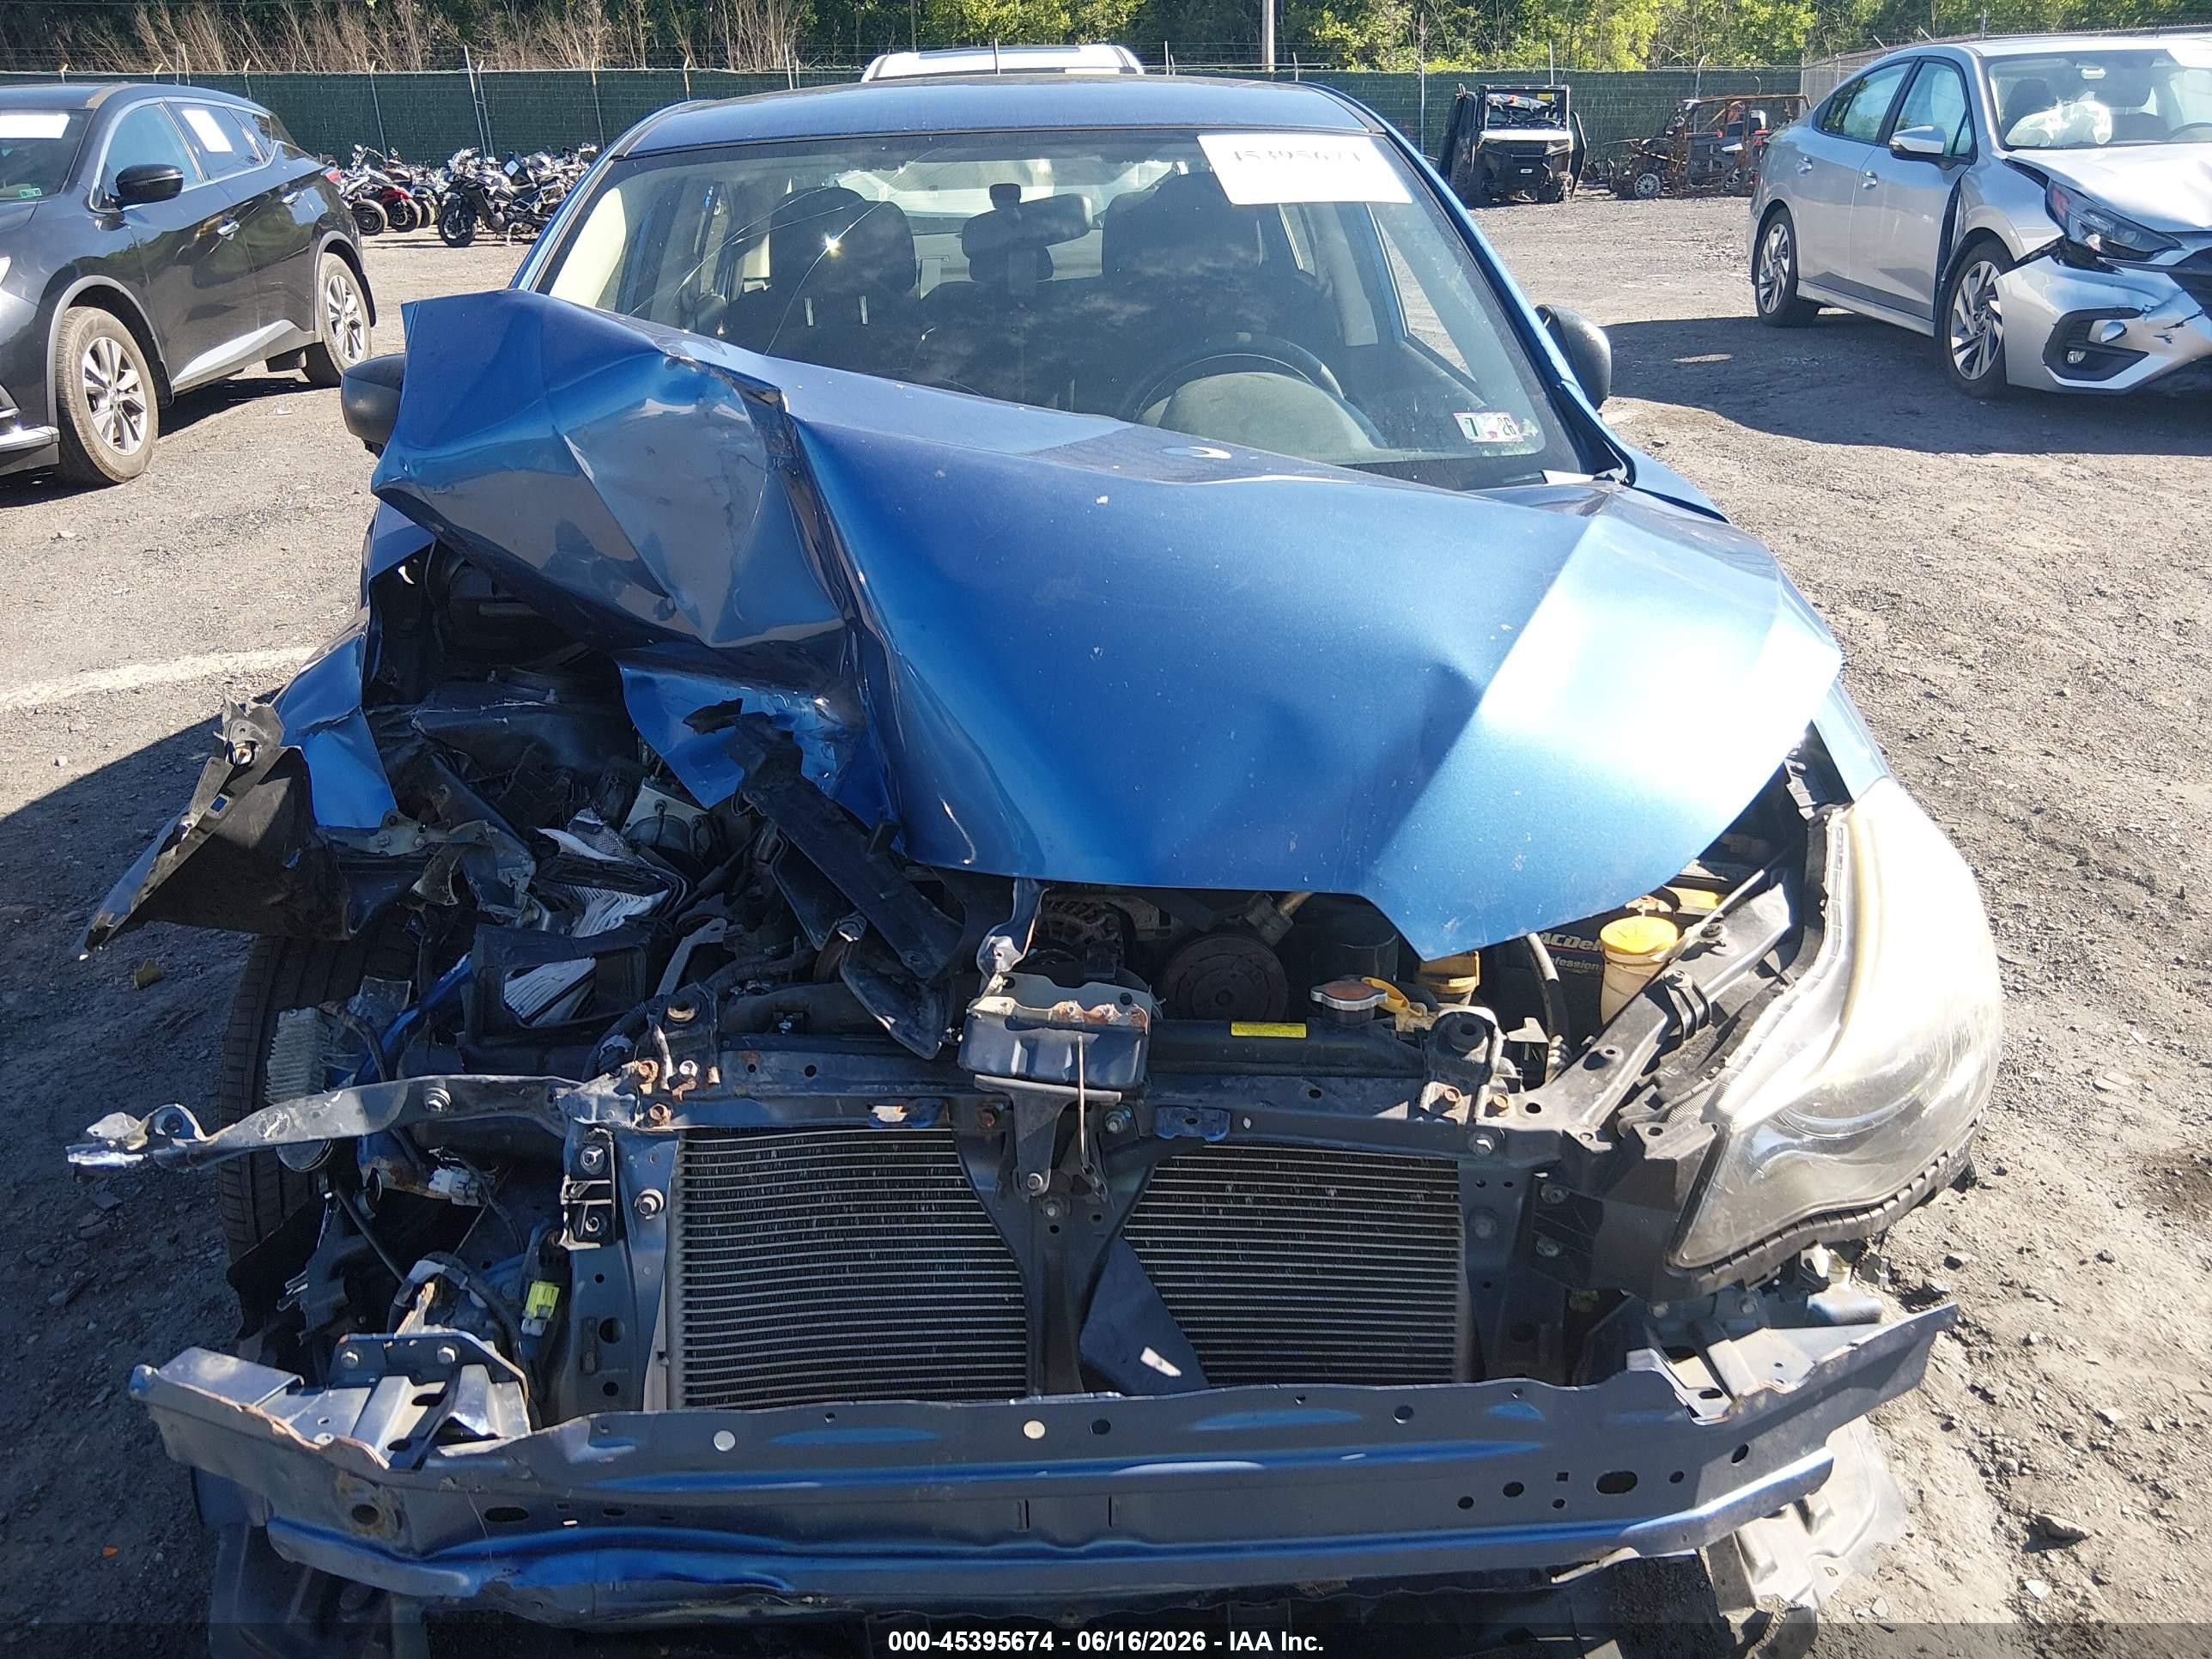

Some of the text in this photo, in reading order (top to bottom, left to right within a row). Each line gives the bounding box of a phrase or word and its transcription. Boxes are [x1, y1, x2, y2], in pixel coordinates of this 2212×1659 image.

[1231, 149, 1361, 163] 453956
[1540, 932, 1603, 952] ACDel
[1552, 956, 1602, 971] fession
